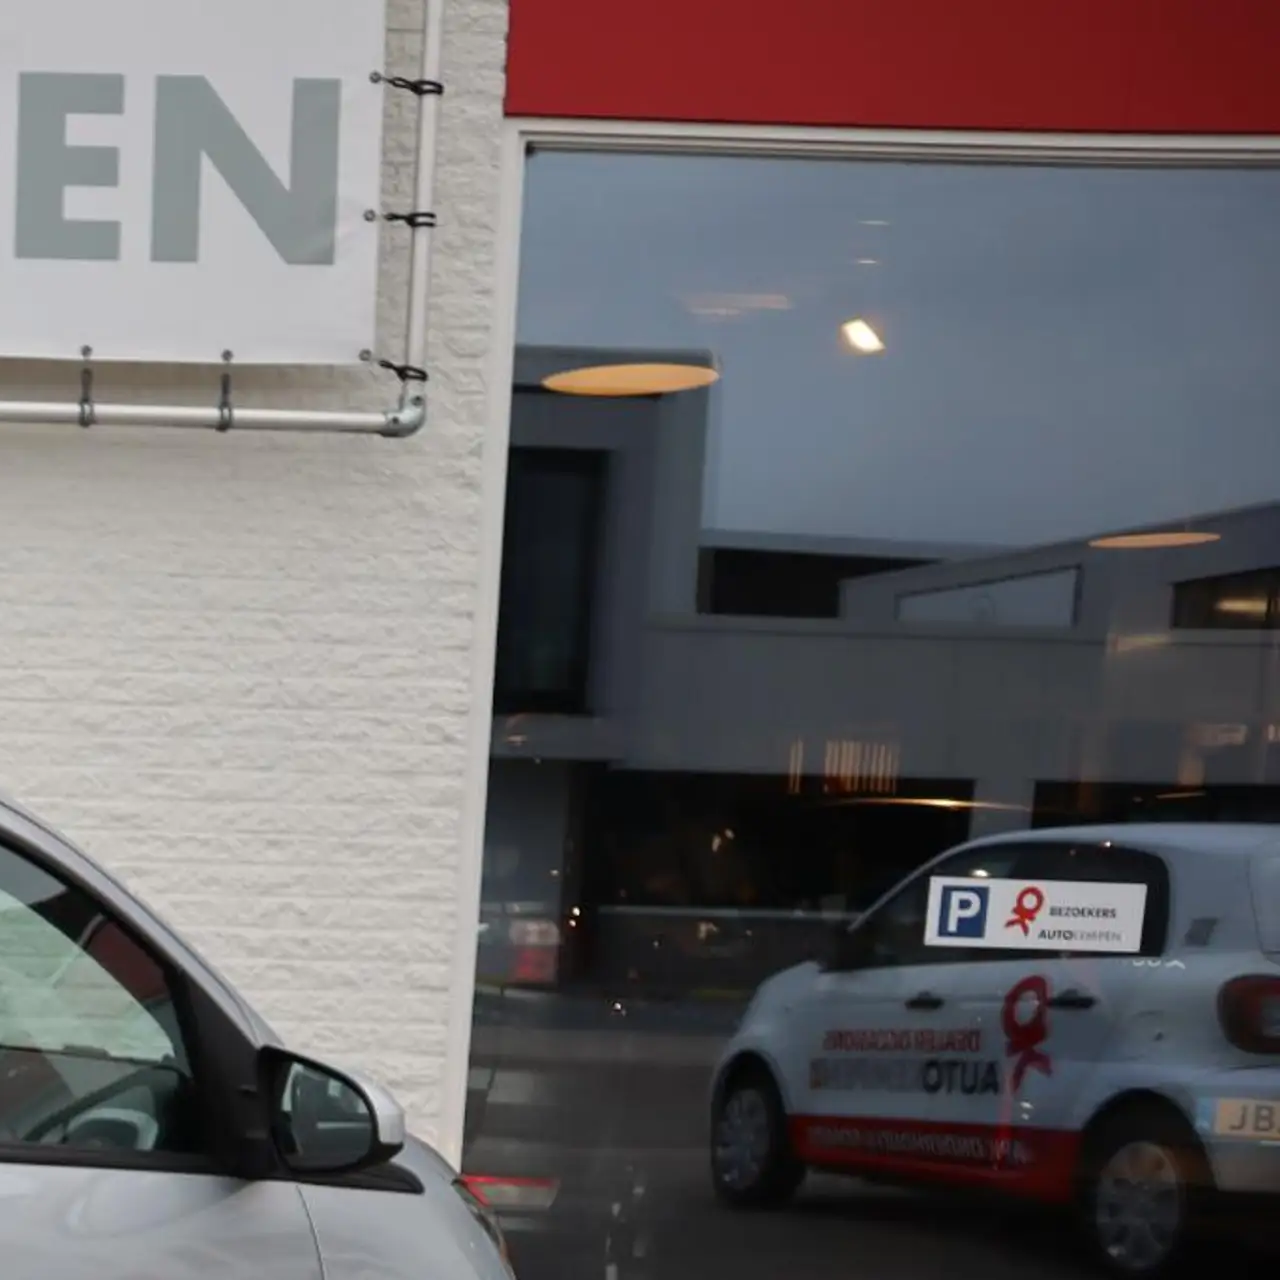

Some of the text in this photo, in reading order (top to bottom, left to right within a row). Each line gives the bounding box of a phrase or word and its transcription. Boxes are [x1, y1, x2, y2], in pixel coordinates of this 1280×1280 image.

[947, 890, 981, 933] P
[1049, 905, 1117, 919] BEZOEKERS
[1228, 1104, 1280, 1133] JB
